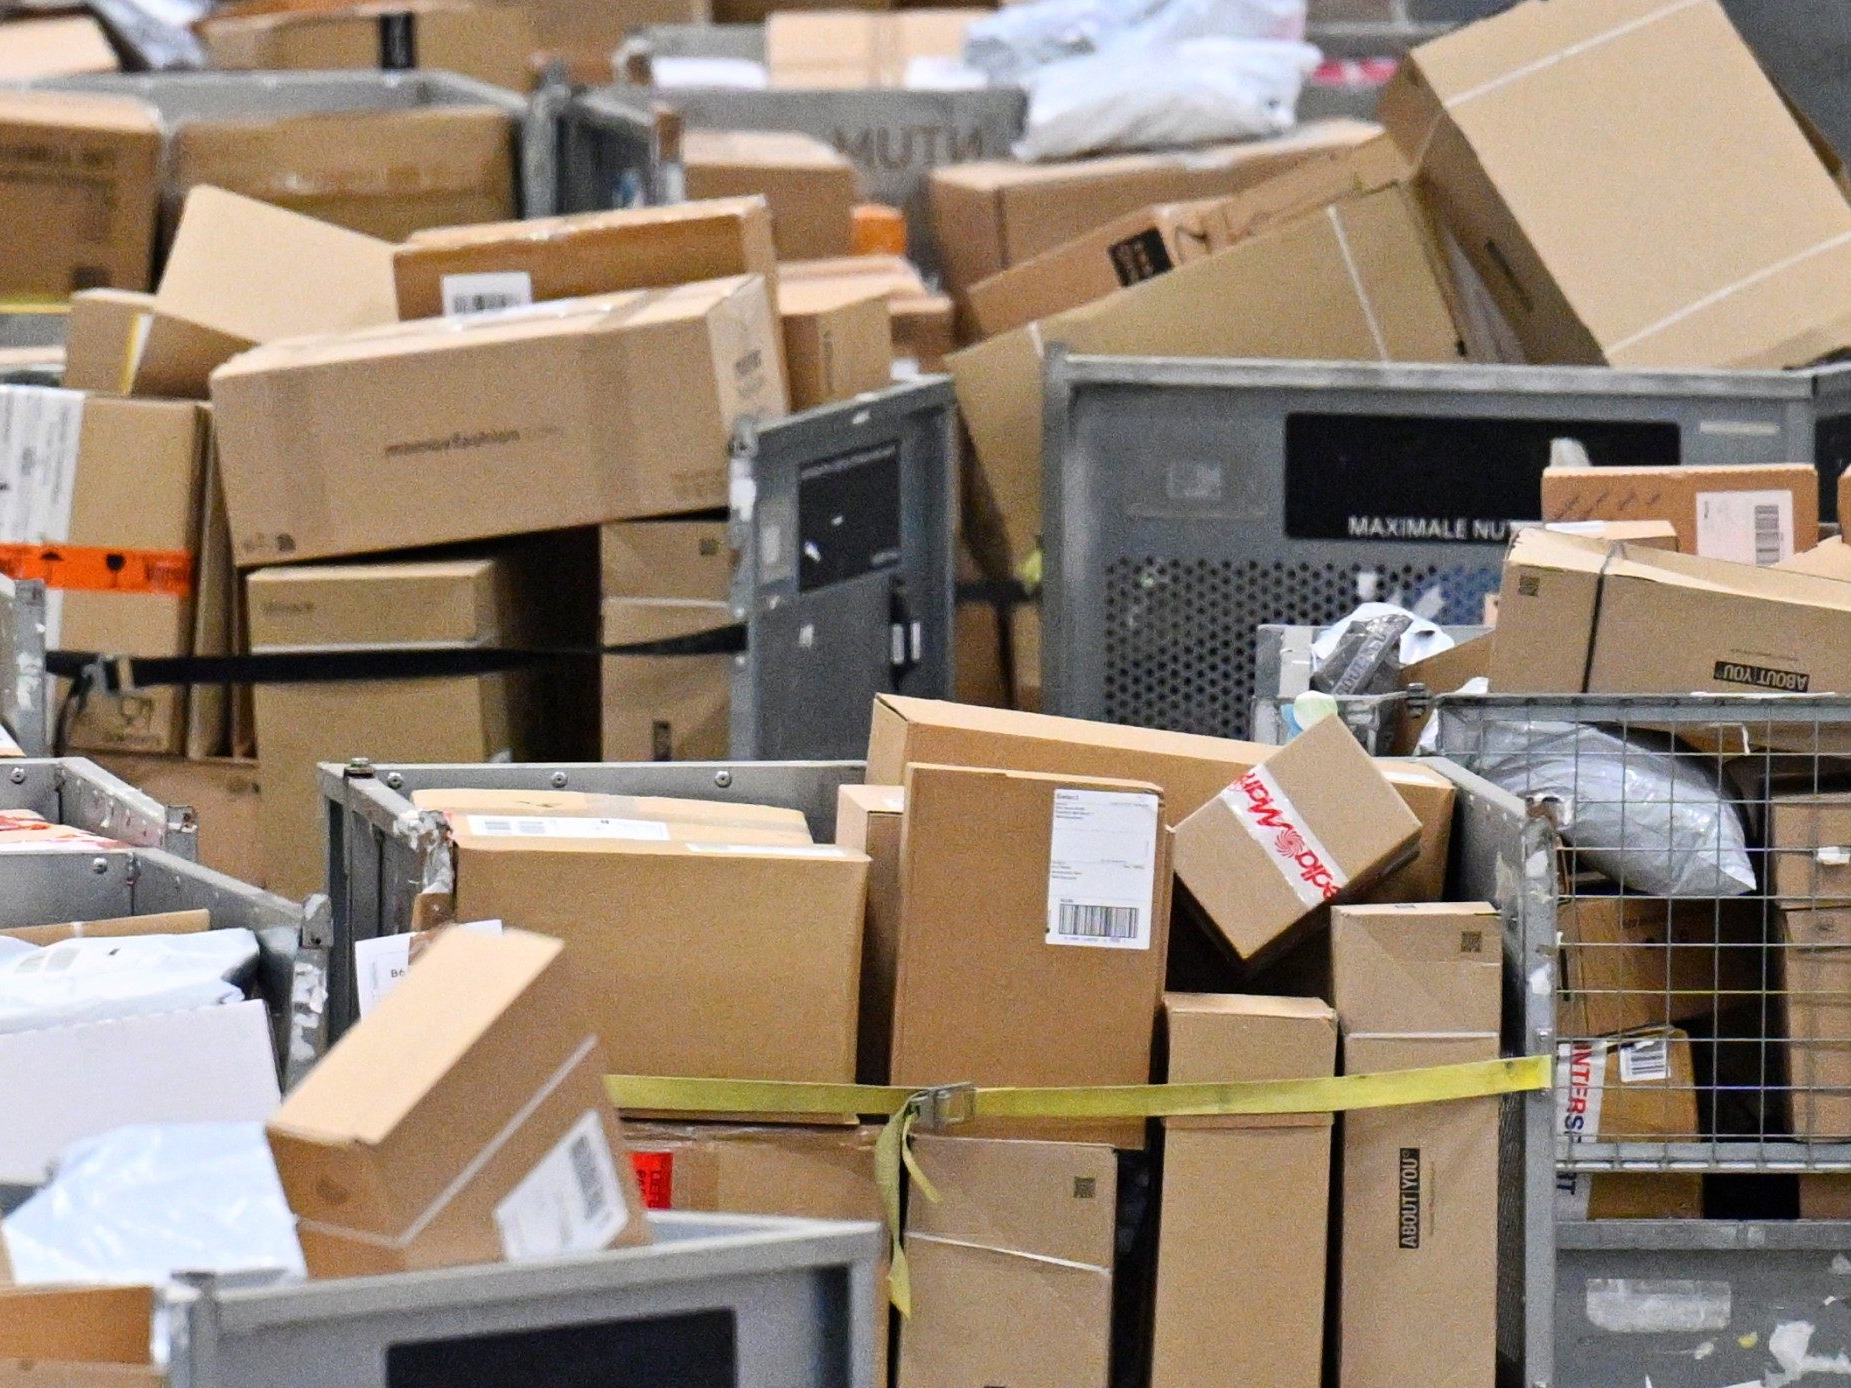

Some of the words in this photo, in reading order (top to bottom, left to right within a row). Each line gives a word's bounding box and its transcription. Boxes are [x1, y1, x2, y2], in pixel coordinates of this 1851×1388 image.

[1348, 515, 1468, 540] MAXIMALE
[1472, 518, 1508, 541] NU
[1756, 667, 1809, 691] ABOUT
[1401, 1196, 1418, 1248] ABOUT
